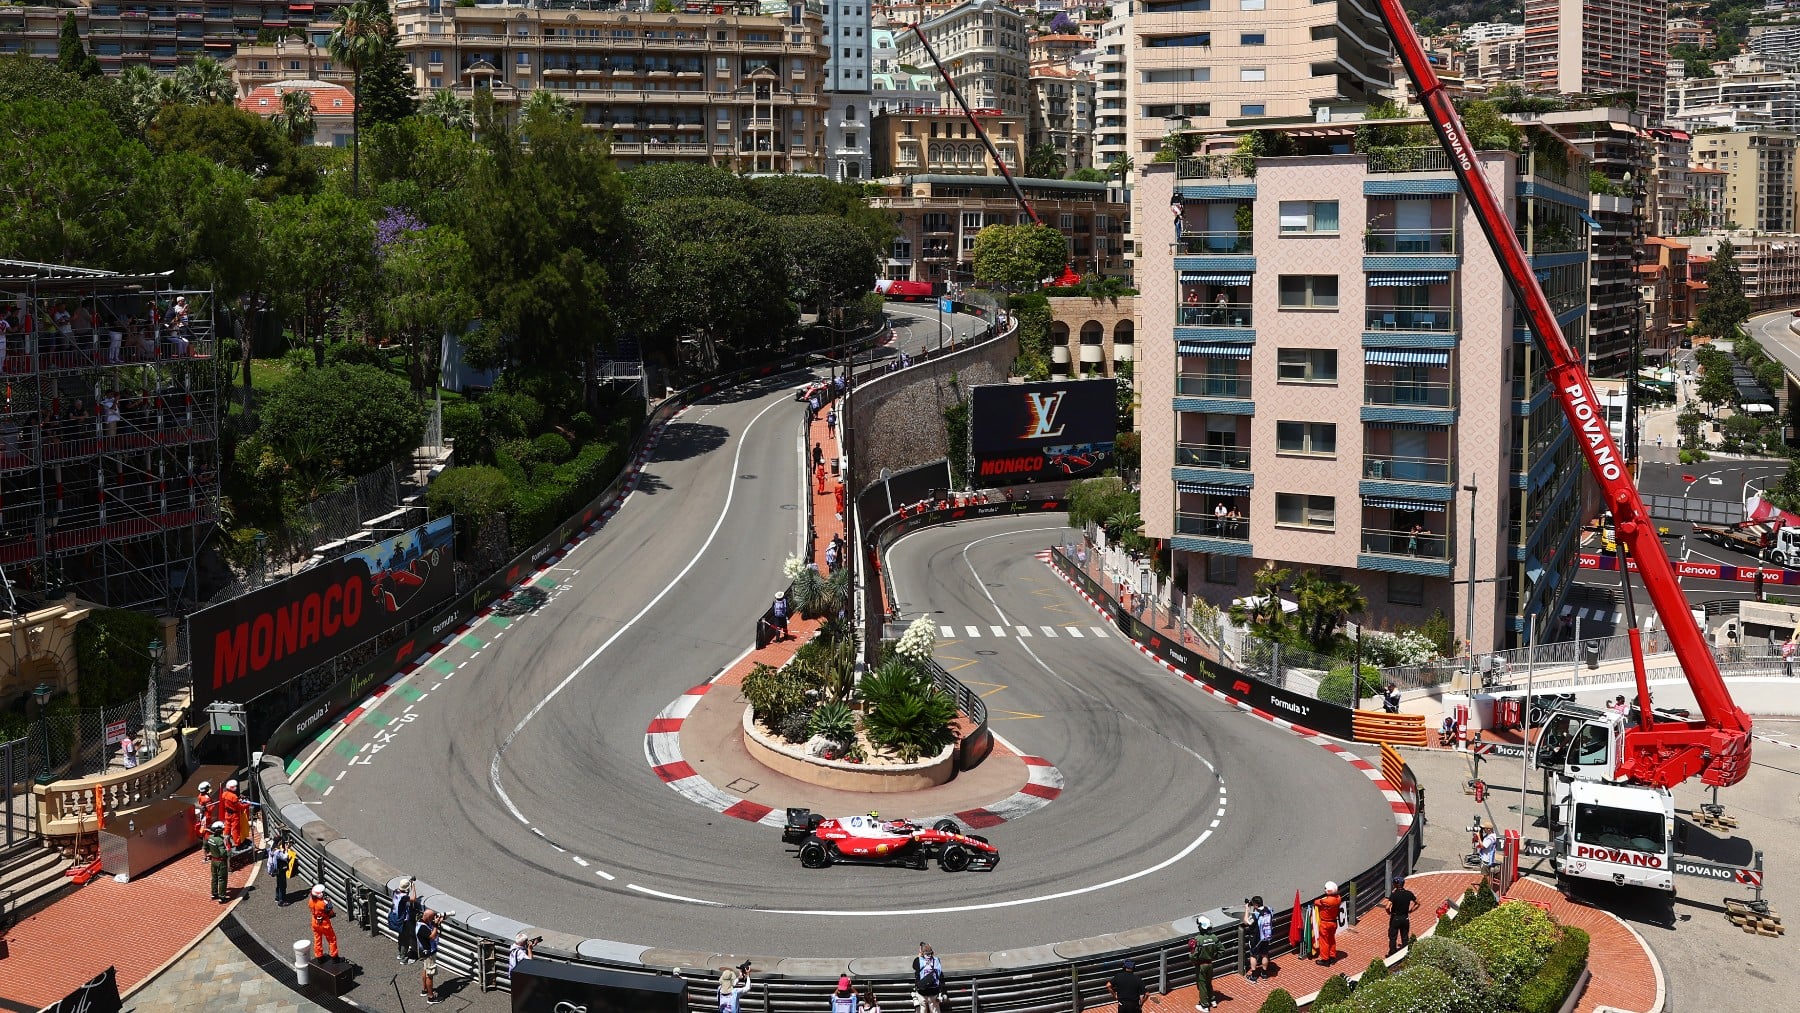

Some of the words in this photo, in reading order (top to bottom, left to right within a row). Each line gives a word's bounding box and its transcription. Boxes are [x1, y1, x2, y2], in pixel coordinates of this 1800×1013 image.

[1443, 122, 1471, 170] PIOVANO
[1565, 384, 1620, 480] PIOVANO
[980, 456, 1043, 476] MONACO
[1679, 565, 1717, 576] Lenovo
[212, 575, 363, 690] MONACO
[432, 614, 453, 634] Formula
[350, 672, 375, 698] Monaco
[1270, 695, 1300, 713] Formula
[296, 707, 323, 734] Formula
[357, 714, 419, 765] TAXIS
[820, 820, 835, 829] 44
[1577, 845, 1662, 868] PIOVANO
[1675, 863, 1731, 879] PIOVANO
